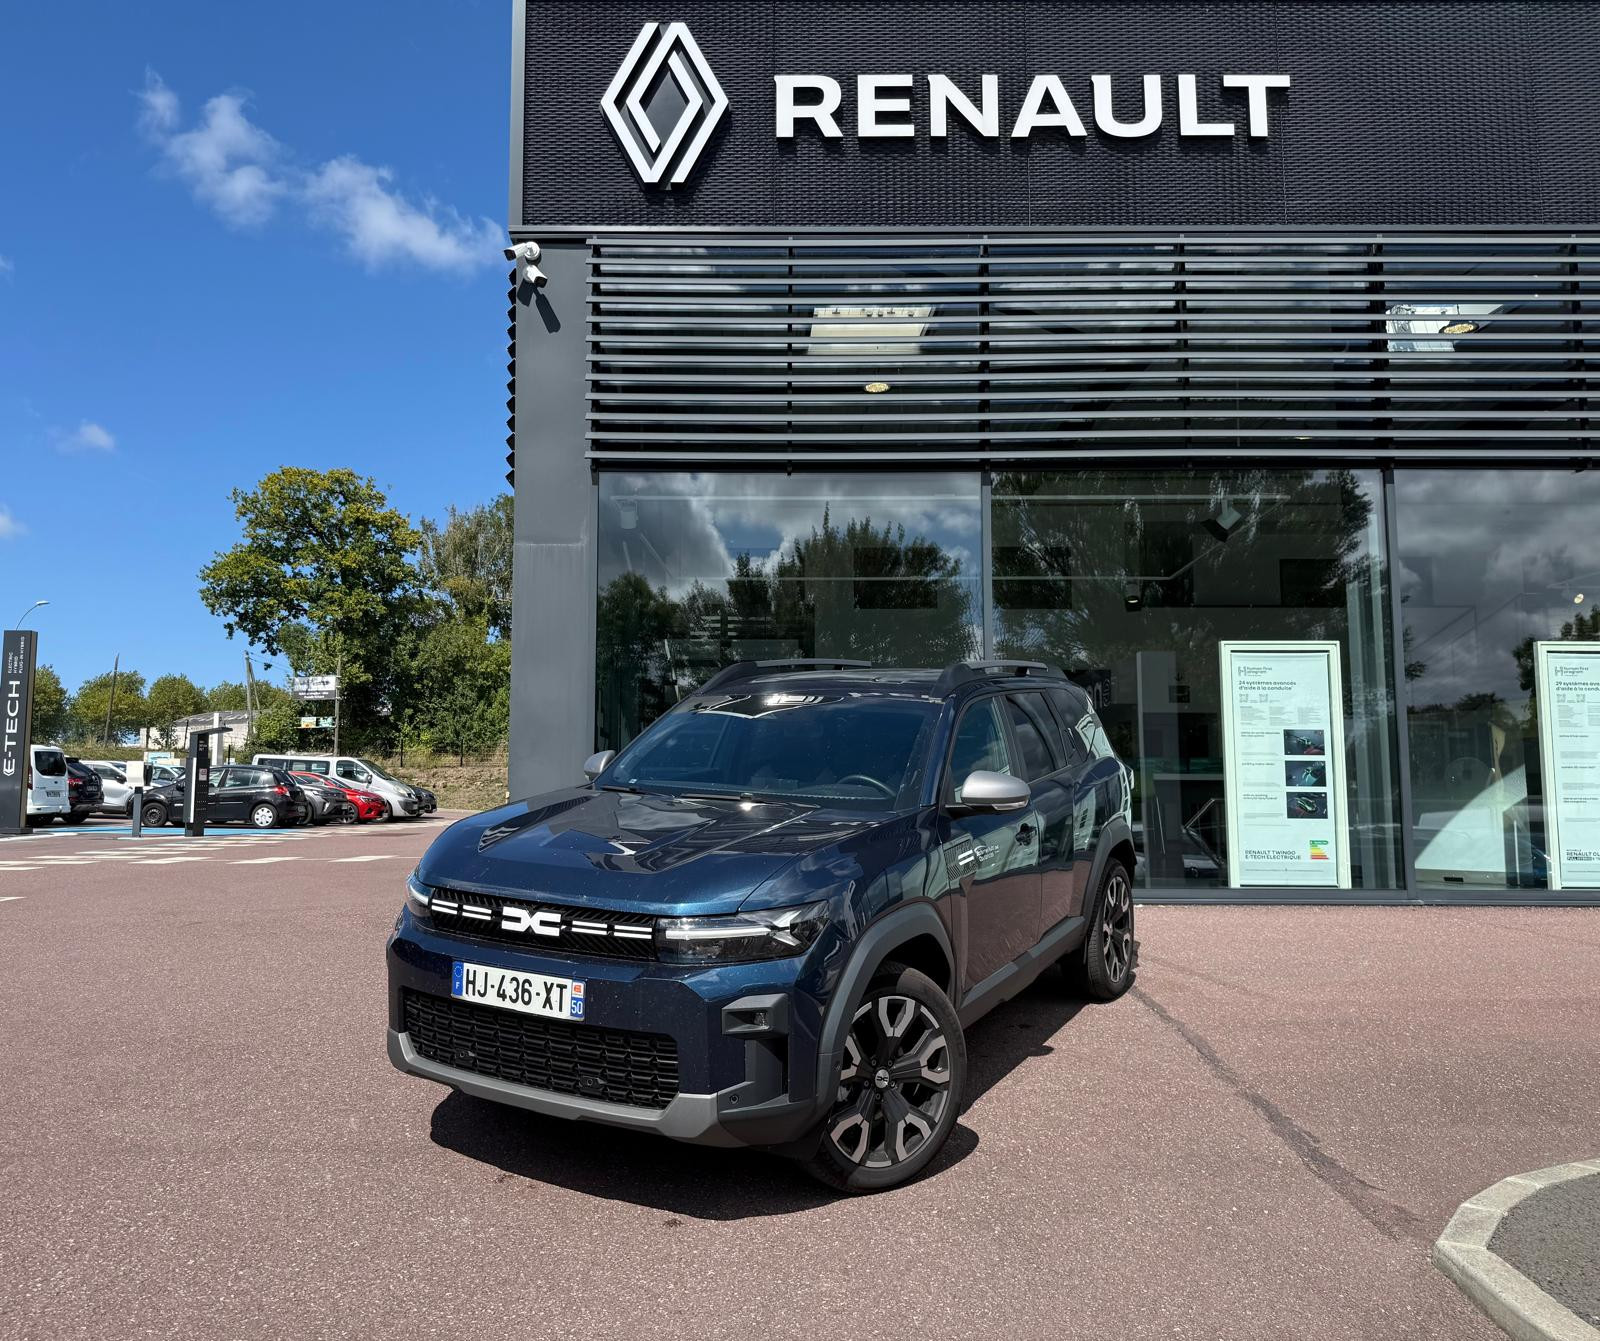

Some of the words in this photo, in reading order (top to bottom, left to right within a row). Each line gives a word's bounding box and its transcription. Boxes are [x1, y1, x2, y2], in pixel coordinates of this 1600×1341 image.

[774, 74, 1290, 137] RENAULT
[3, 680, 20, 776] E-TECH
[465, 968, 567, 1013] HJ-436-XT
[571, 1001, 583, 1014] 50
